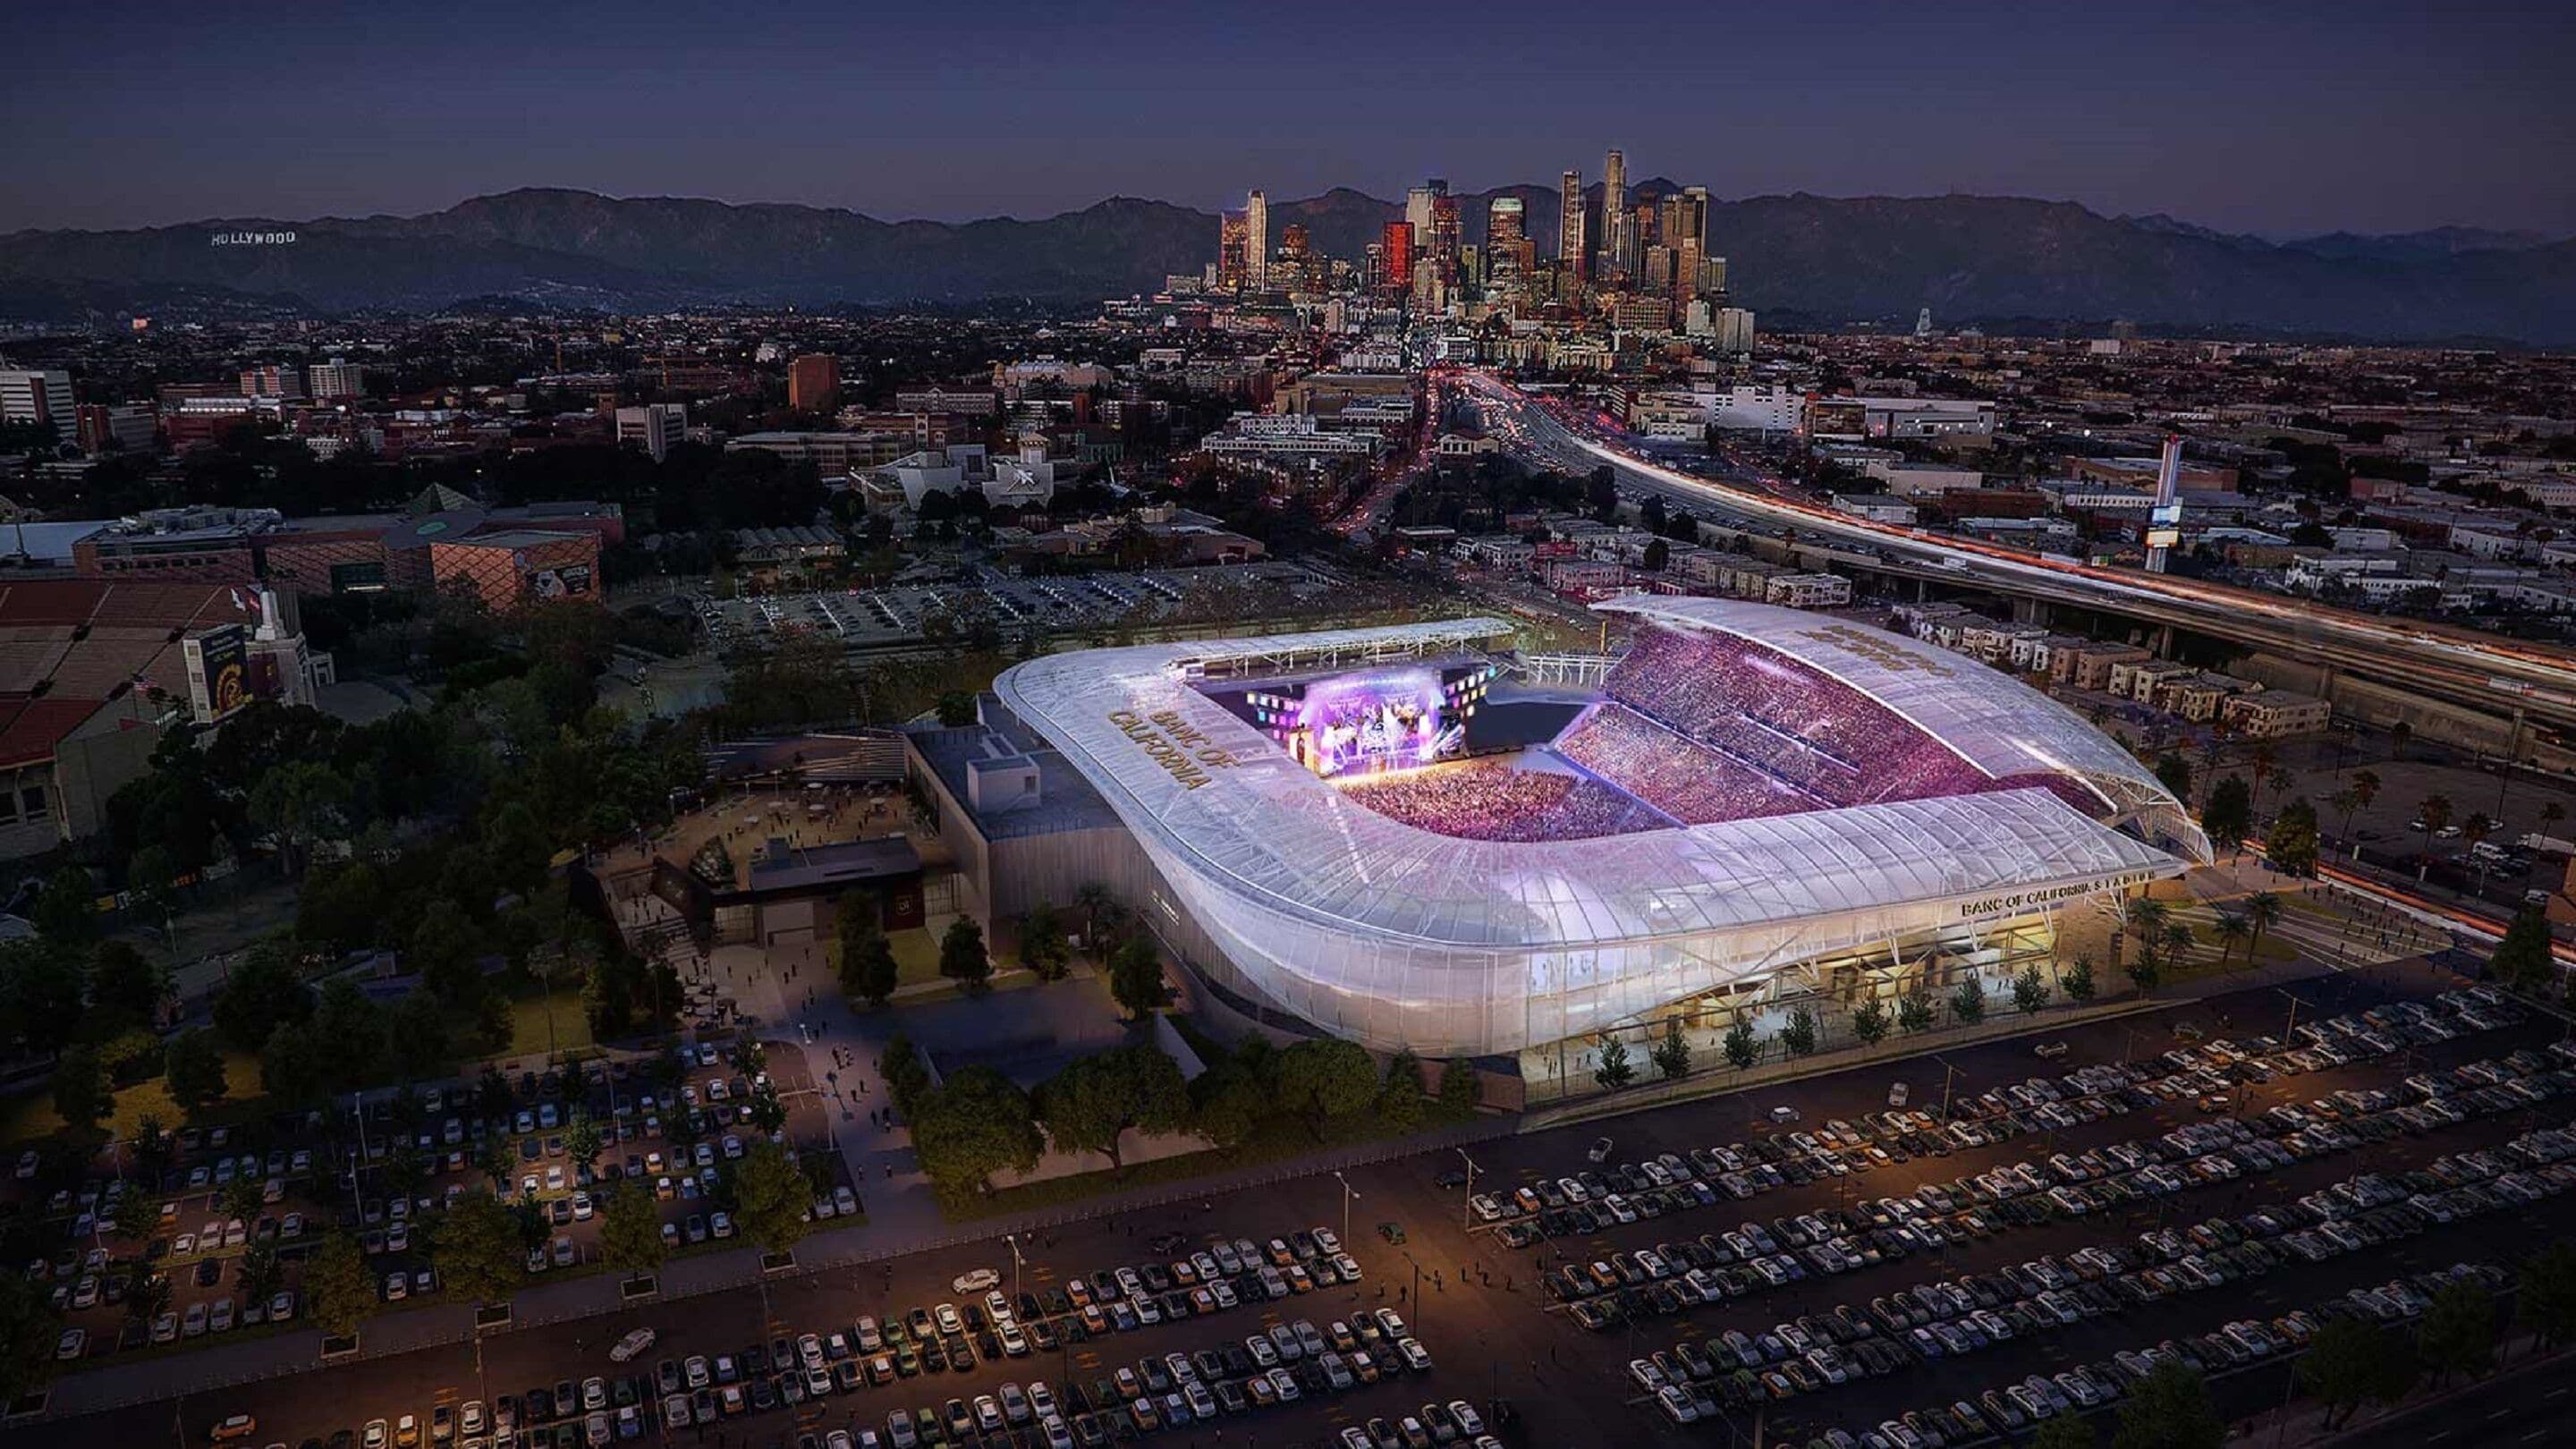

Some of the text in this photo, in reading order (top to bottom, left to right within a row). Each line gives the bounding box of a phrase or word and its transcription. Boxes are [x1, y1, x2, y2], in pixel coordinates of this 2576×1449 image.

[211, 231, 296, 246] HOLLYWOOD
[1109, 711, 1212, 790] CALIFORNIA
[1149, 711, 1241, 768] BANC OF
[1962, 897, 2003, 917] BANC
[2005, 894, 2023, 908] OF
[2026, 882, 2091, 904] CALIFORNIA
